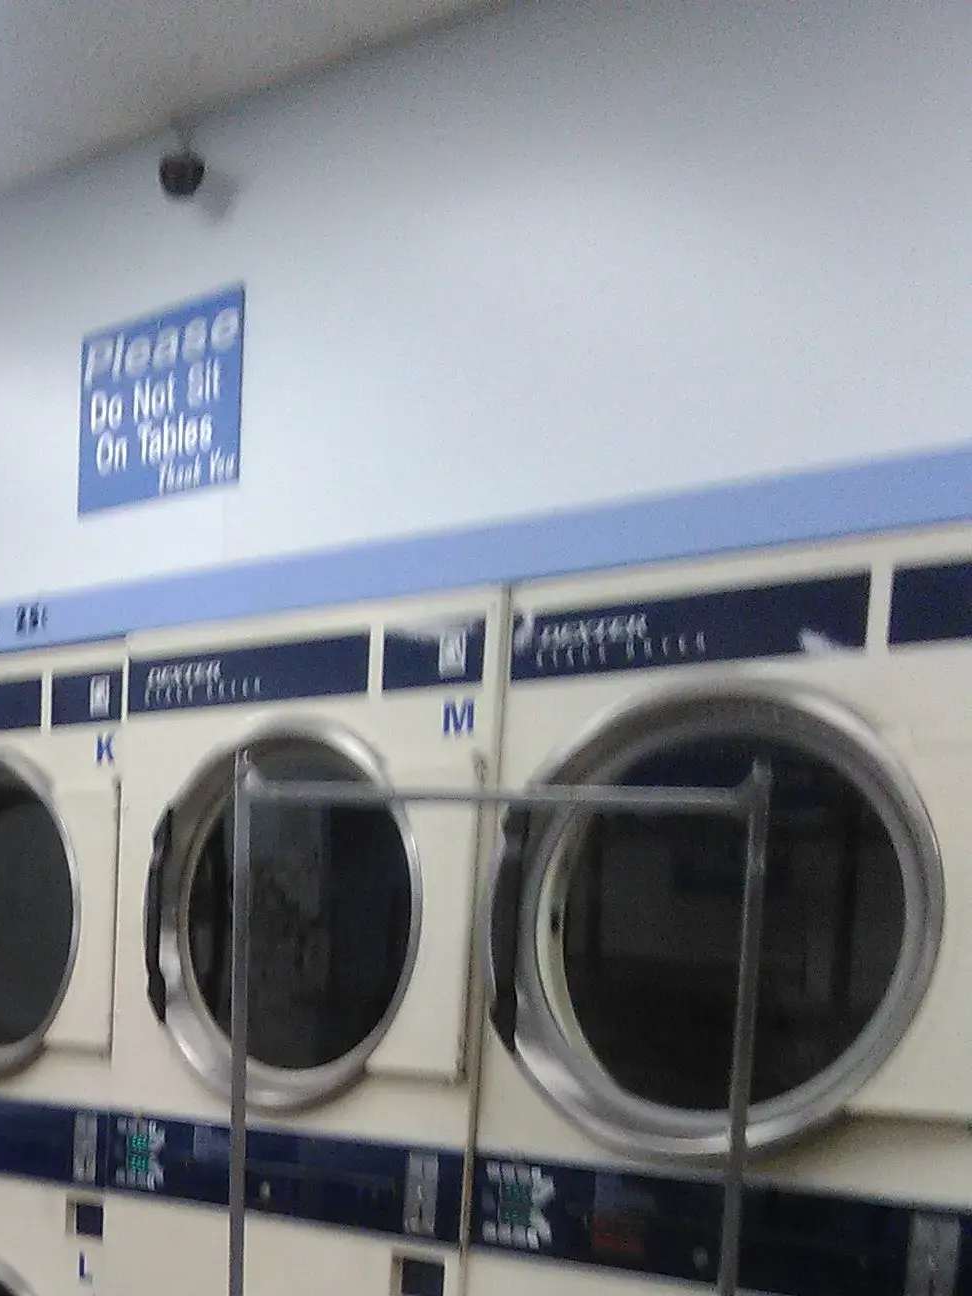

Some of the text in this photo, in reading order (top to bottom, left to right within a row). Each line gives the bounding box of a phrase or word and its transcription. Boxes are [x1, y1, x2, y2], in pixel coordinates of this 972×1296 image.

[84, 307, 240, 390] Please
[90, 390, 123, 435] Do
[133, 369, 177, 424] Not
[96, 411, 213, 477] On Tables
[159, 453, 203, 496] Thank
[442, 698, 474, 736] M
[97, 734, 114, 766] K
